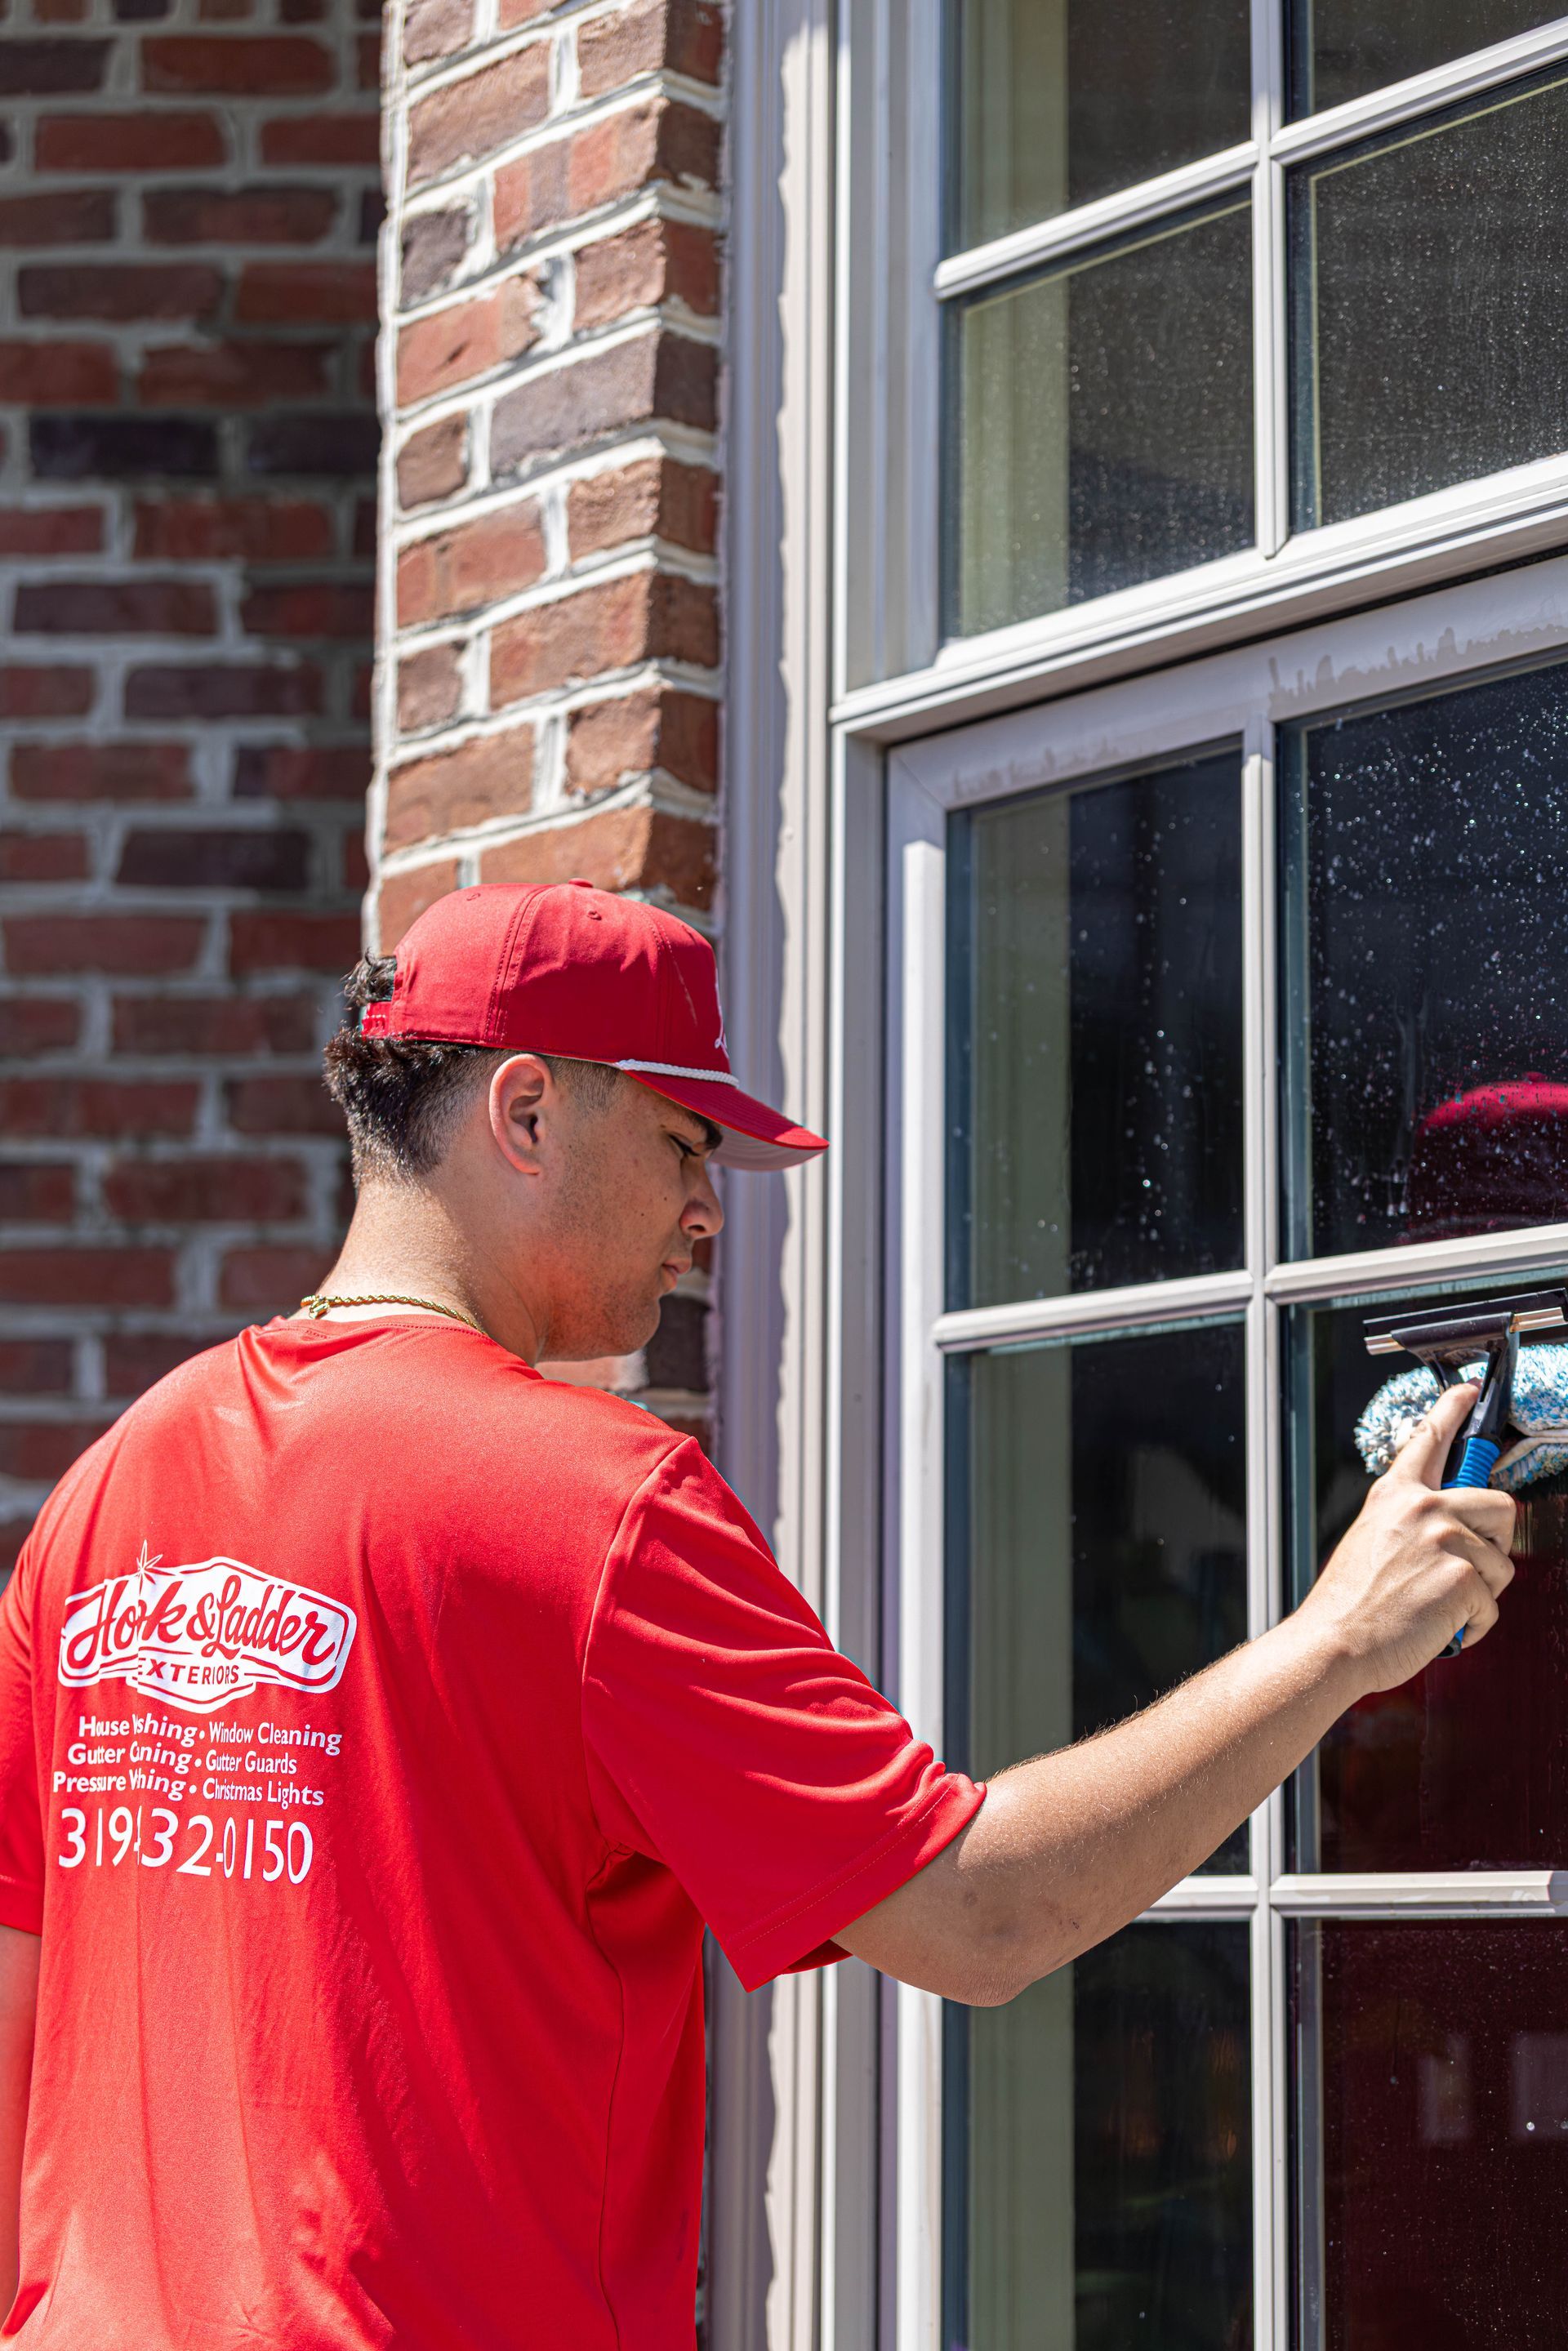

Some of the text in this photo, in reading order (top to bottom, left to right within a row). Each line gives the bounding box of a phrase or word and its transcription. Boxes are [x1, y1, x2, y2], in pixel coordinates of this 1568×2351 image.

[185, 1592, 216, 1641] &
[201, 1574, 336, 1666] Ladder
[78, 1715, 131, 1738] House
[208, 1721, 255, 1744] Window
[257, 1721, 343, 1757] Cleaning
[67, 1743, 127, 1765] Gutter
[205, 1749, 243, 1773] Gutter
[244, 1750, 298, 1775] Guards
[52, 1770, 127, 1794] Pressure
[202, 1777, 264, 1802] Christmas
[266, 1780, 325, 1810] Lights
[58, 1804, 314, 1885] 319-32-0150
